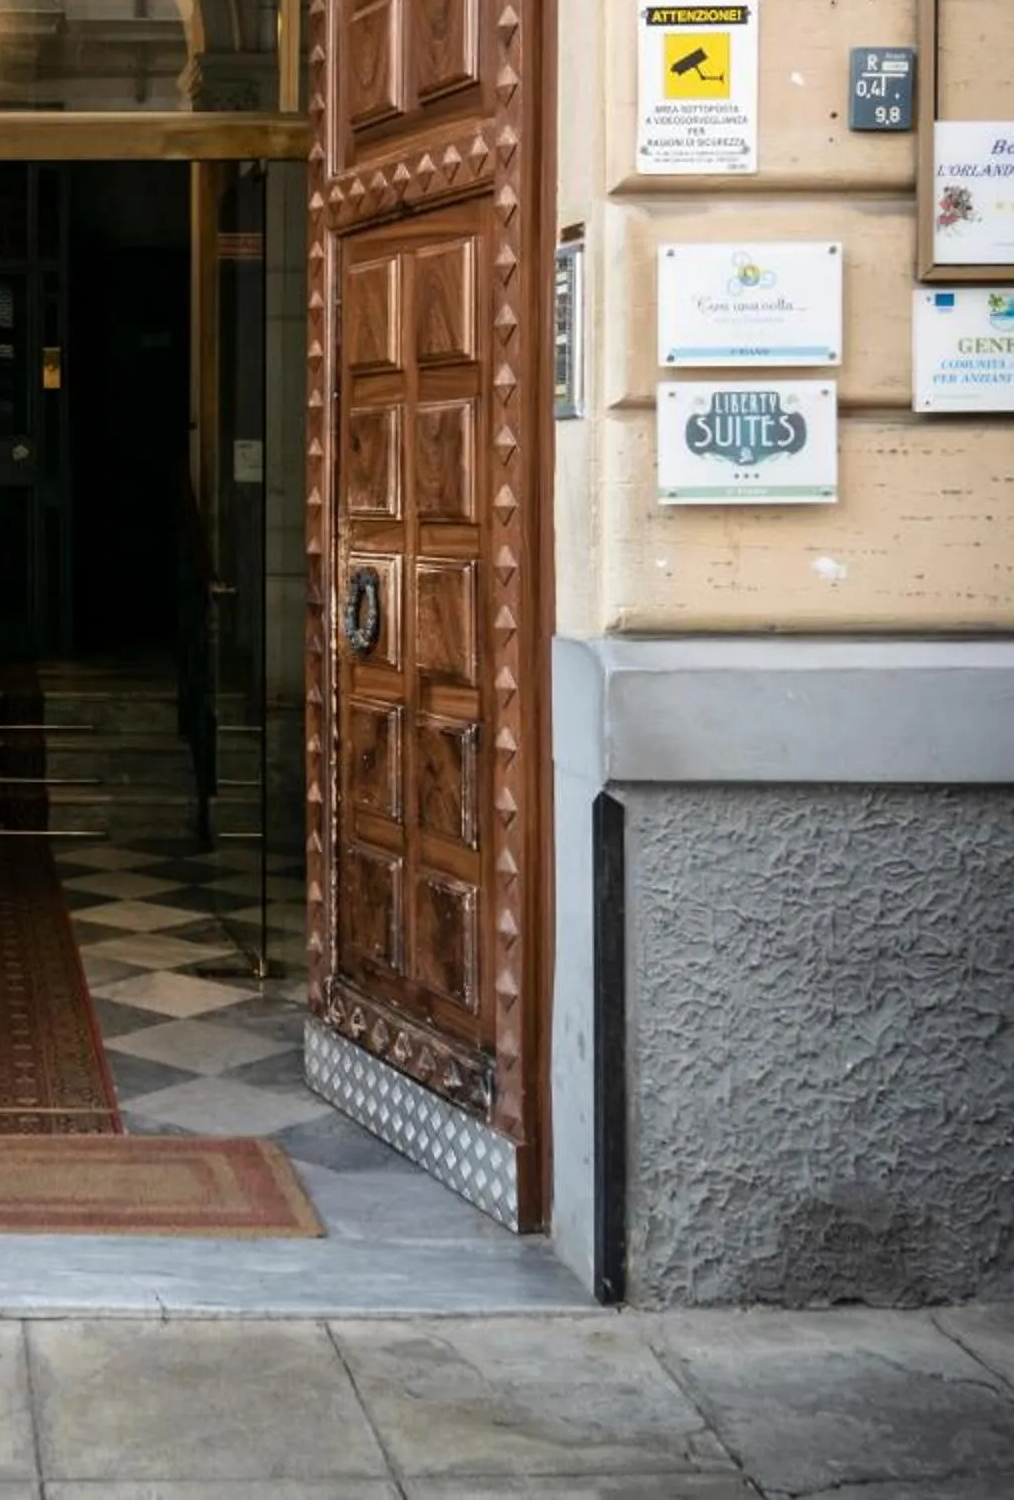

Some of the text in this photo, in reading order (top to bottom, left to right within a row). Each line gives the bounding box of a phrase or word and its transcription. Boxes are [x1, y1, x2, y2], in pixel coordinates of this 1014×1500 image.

[652, 9, 741, 22] ATTENZIONE!
[866, 54, 878, 71] R
[875, 106, 901, 125] 9,8
[715, 393, 777, 414] LIBERTY
[694, 415, 795, 447] SUITES
